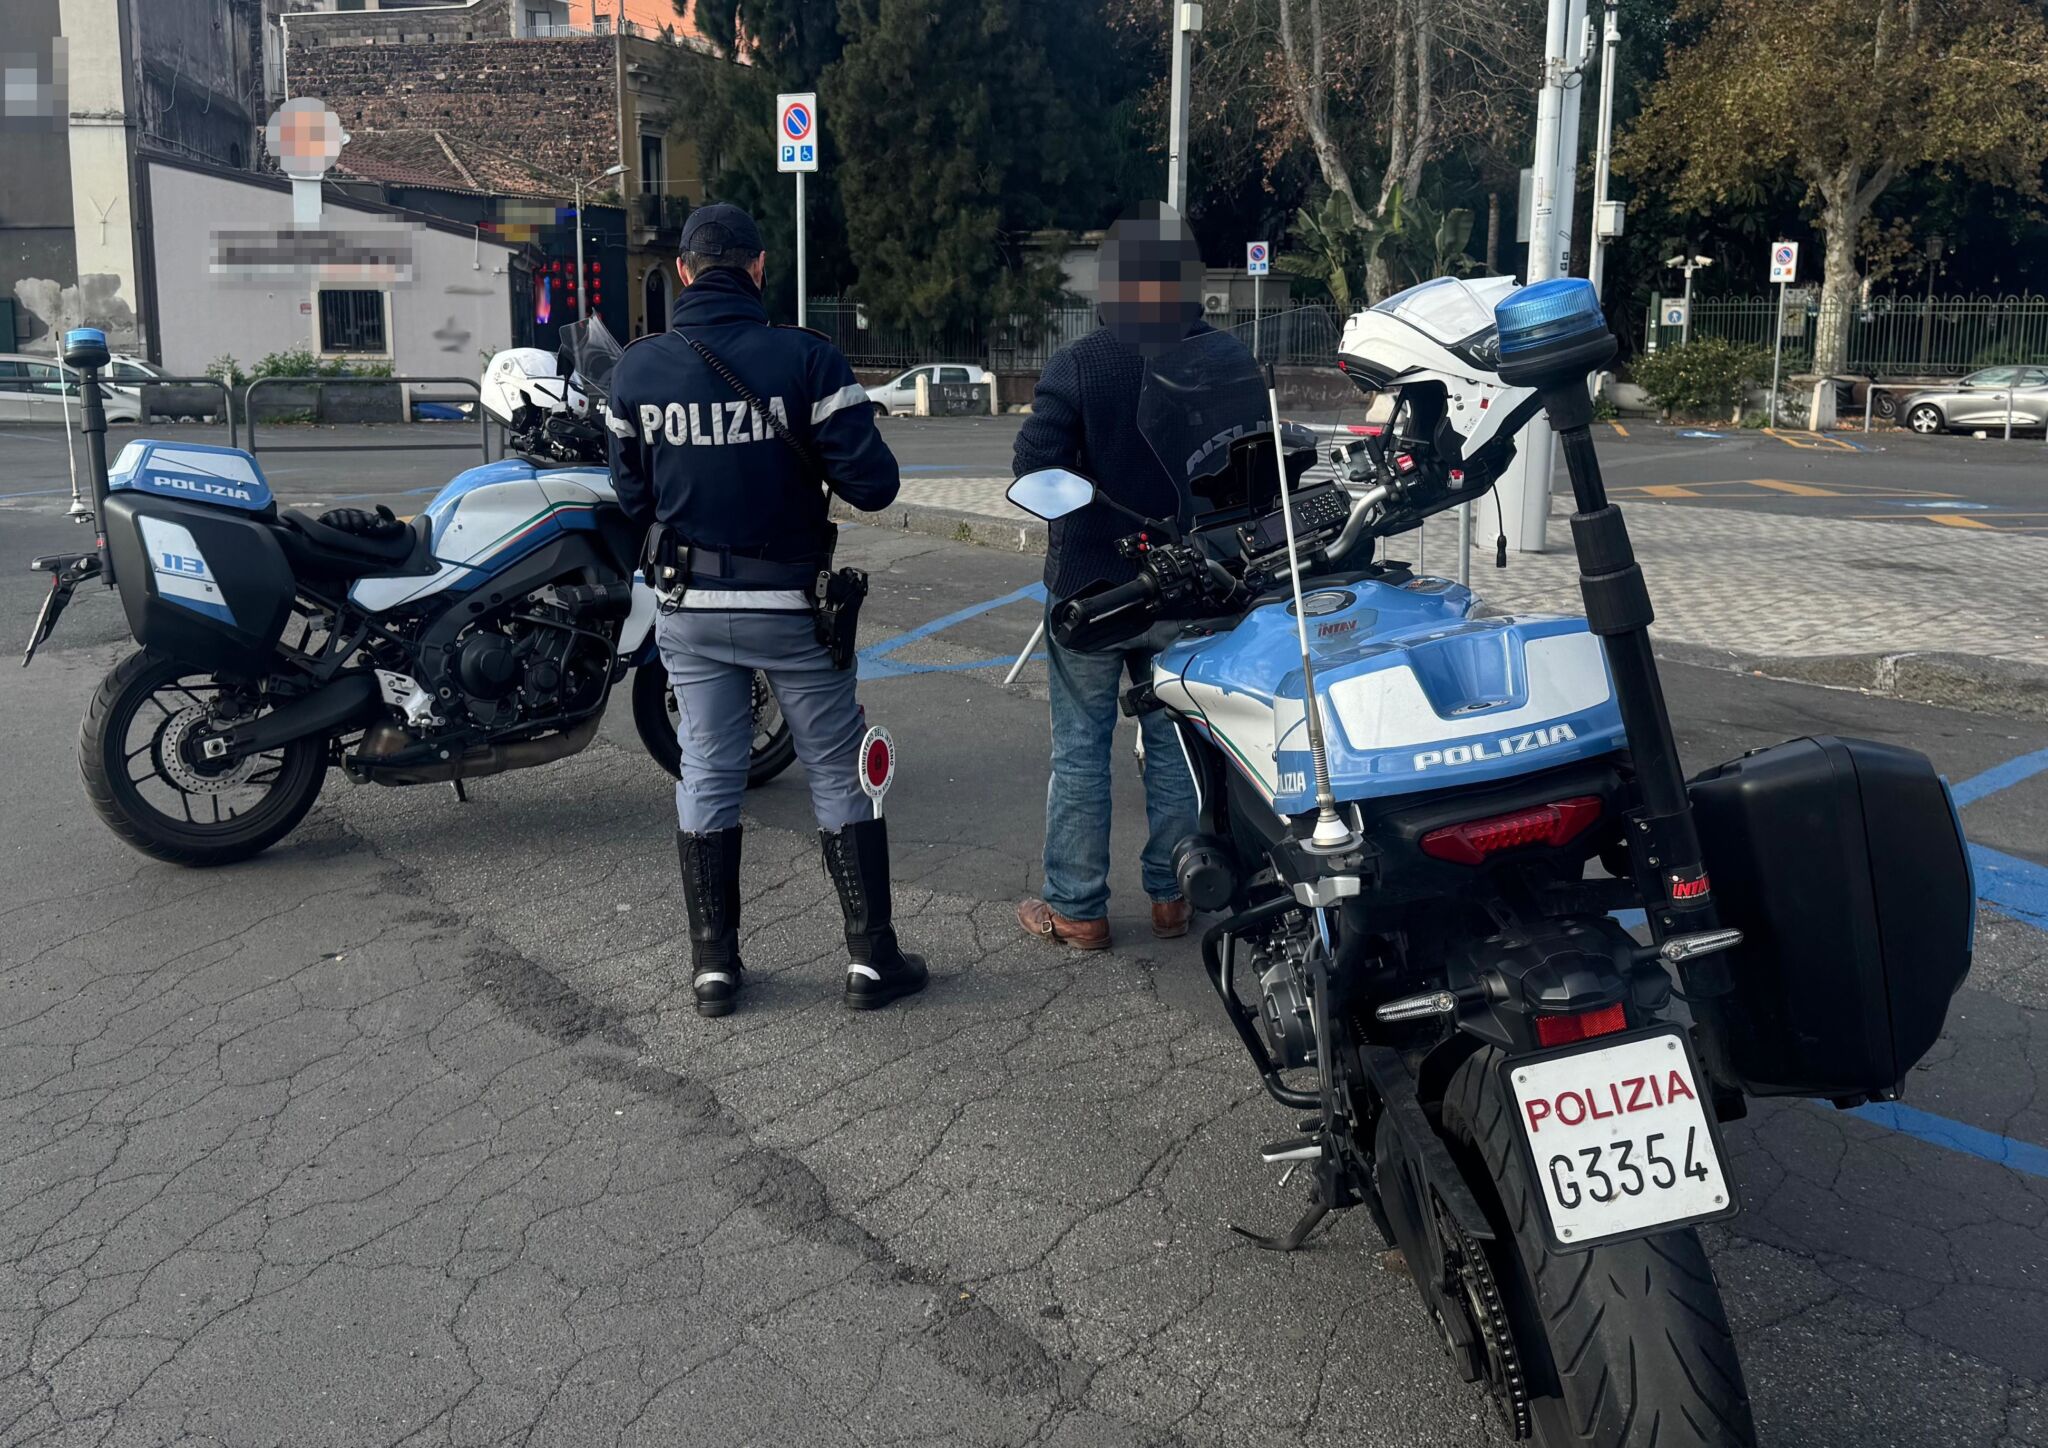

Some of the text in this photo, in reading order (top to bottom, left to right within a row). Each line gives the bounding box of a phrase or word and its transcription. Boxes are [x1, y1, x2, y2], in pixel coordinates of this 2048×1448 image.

[783, 147, 793, 161] P
[640, 396, 789, 446] POLIZIA
[154, 476, 251, 501] POLIZIA
[162, 552, 204, 574] 113
[1413, 723, 1577, 772] POLIZIA
[1525, 1070, 1695, 1132] POLIZIA
[1549, 1126, 1709, 1209] G3354
